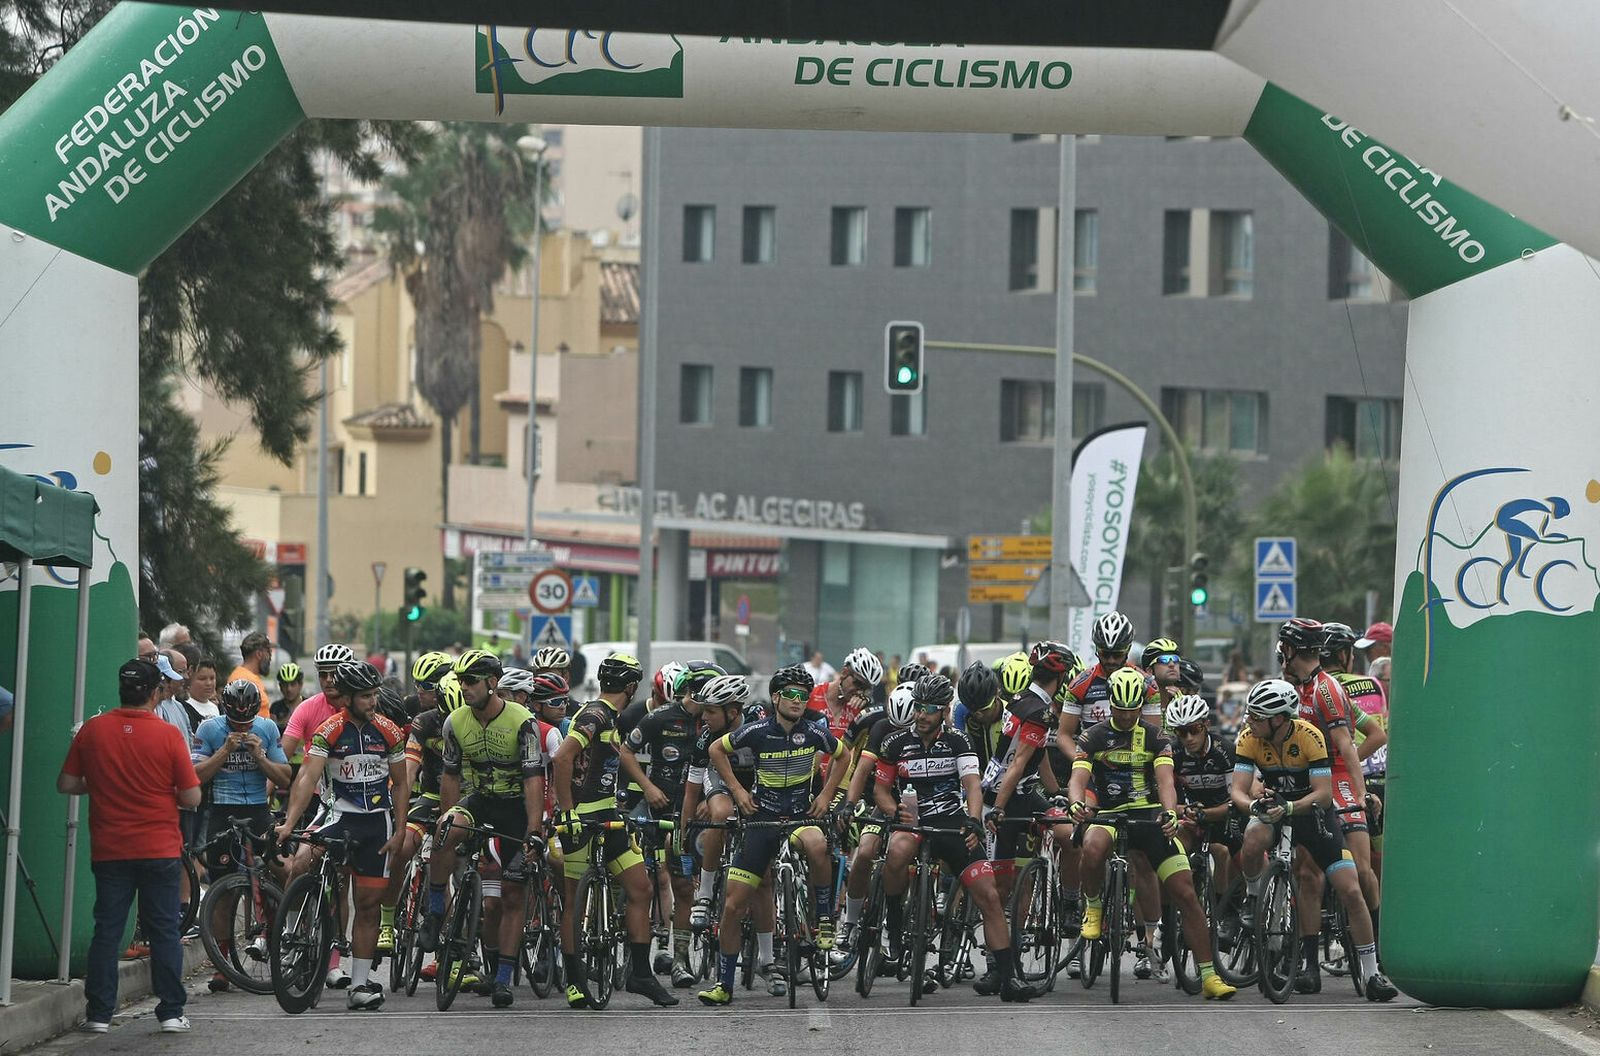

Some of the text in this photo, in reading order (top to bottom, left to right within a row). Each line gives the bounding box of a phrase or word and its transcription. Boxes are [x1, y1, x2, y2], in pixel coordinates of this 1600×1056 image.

[55, 9, 221, 164] FEDERACIÓN
[794, 57, 1073, 90] DE CICLISMO
[44, 80, 188, 222] ANDALUZA
[104, 44, 267, 204] DE CICLISMO
[1361, 145, 1486, 264] CICLISMO
[694, 492, 728, 520] AC
[732, 495, 865, 530] ALGECIRAS
[539, 583, 566, 600] 30
[909, 760, 956, 772] La Palma
